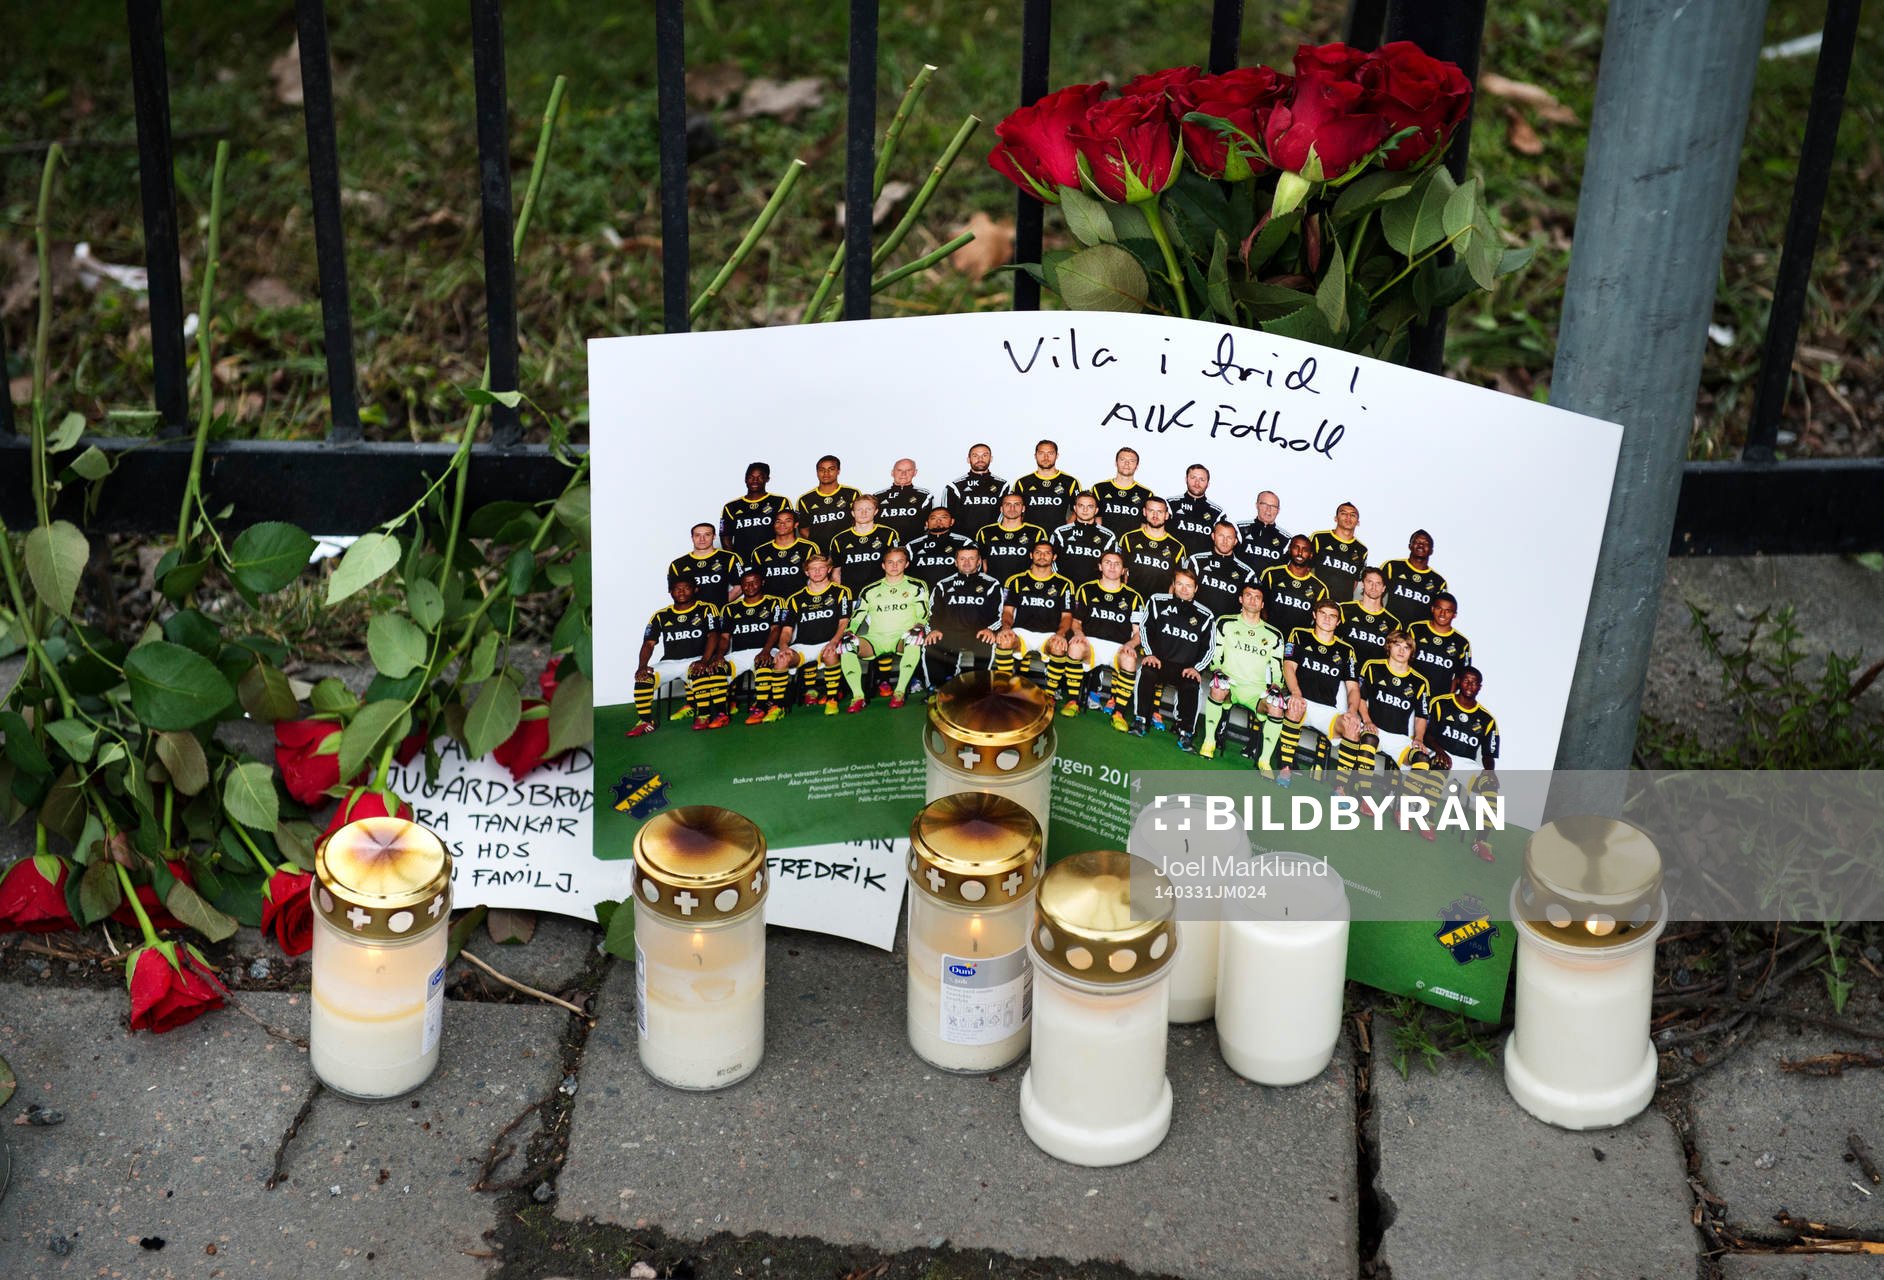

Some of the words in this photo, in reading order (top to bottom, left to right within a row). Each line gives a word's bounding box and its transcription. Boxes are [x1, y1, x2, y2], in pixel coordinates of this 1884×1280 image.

[1003, 327, 1118, 373] Vila
[1160, 337, 1171, 375] i
[1201, 332, 1320, 394] frid
[1100, 399, 1197, 433] AIK
[1209, 404, 1346, 460] Fotboll
[694, 574, 721, 585] BRO
[1052, 756, 1093, 776] ngen
[1099, 765, 1142, 792] 2014
[468, 813, 579, 837] TANKAR
[478, 842, 531, 859] HOS
[766, 857, 887, 892] FREDRIK
